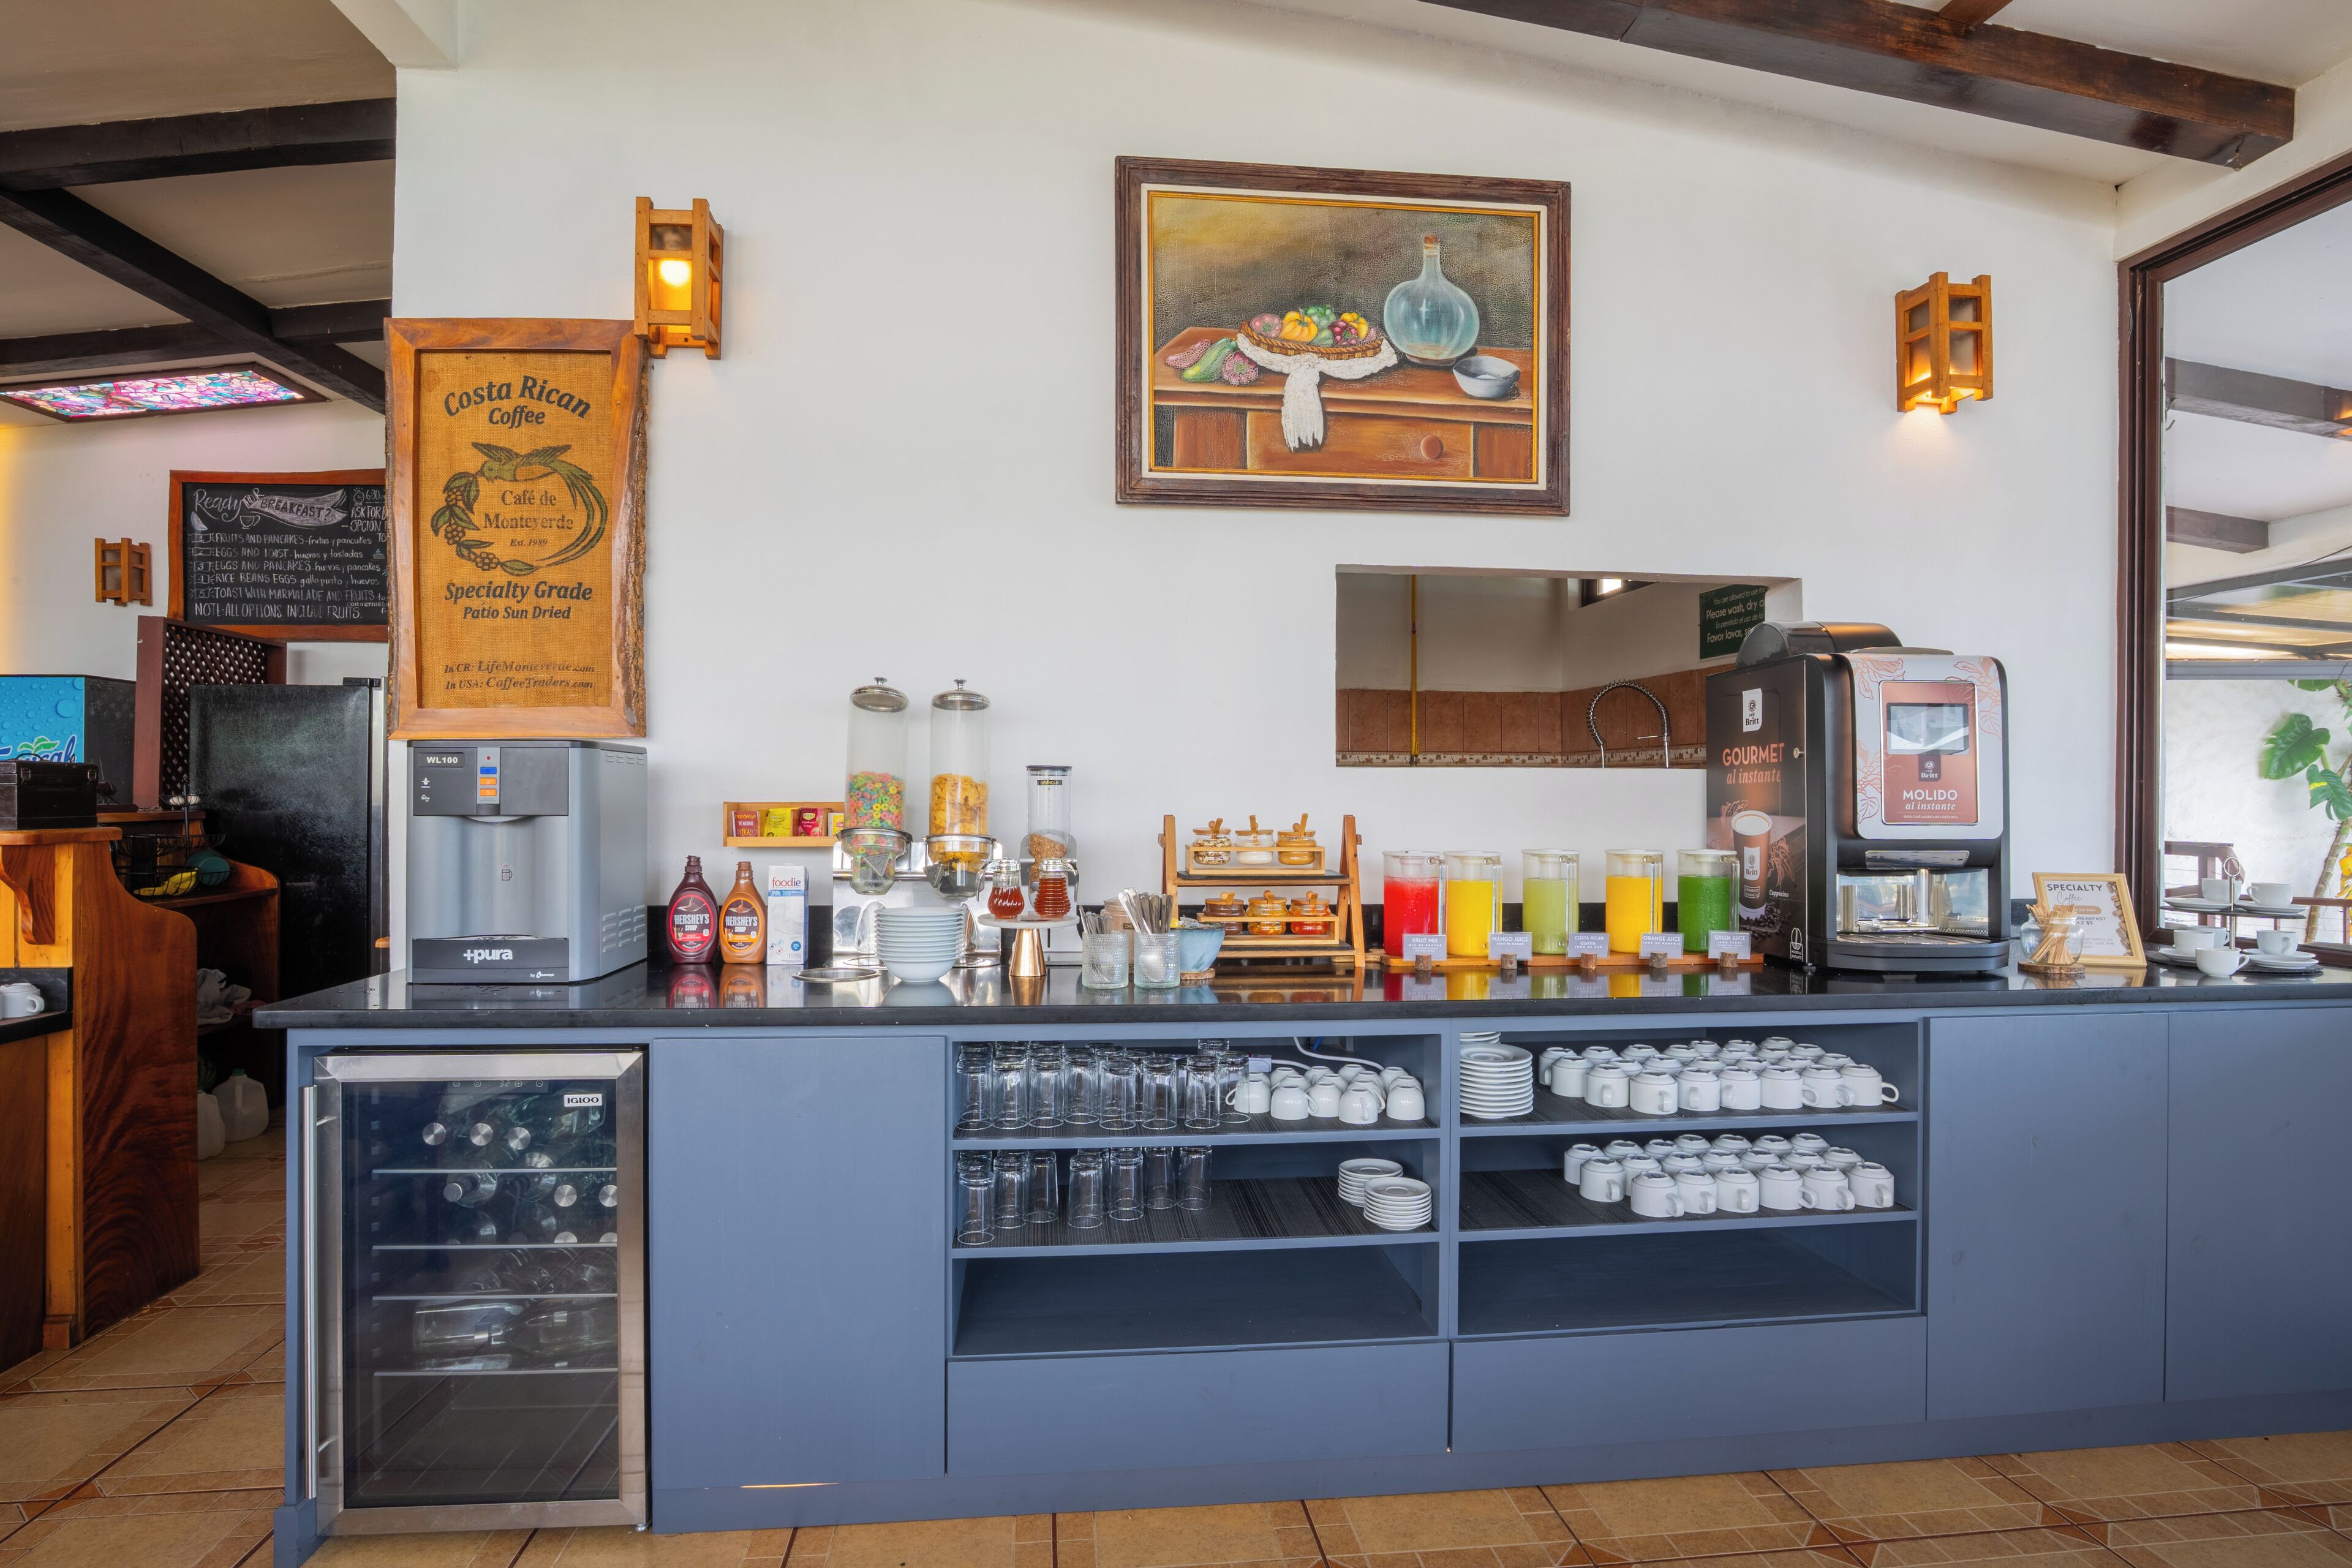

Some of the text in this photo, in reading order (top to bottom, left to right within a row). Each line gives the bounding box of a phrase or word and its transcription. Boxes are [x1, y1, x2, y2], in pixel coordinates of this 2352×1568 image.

[444, 374, 591, 419] Costa Rican
[488, 404, 546, 429] Coffee
[501, 489, 557, 506] Café de
[194, 489, 242, 522] Ready
[260, 498, 331, 521] BREAKFAST?
[351, 507, 365, 519] ASK
[483, 513, 574, 530] Monteverde
[216, 533, 244, 544] FRUITS
[246, 533, 264, 544] AND
[337, 536, 372, 547] pancakes
[510, 538, 548, 547] Est. 1989
[215, 546, 238, 557] EGGS
[241, 547, 260, 557] AND
[215, 560, 238, 570] EGGS
[241, 560, 260, 571] AND
[347, 562, 382, 573] pancakes
[215, 573, 235, 583] RICE
[240, 572, 270, 583] BEANS
[273, 573, 297, 584] EGGS
[300, 574, 319, 587] gallo
[320, 575, 343, 587] pinto
[351, 575, 380, 586] huevos
[214, 587, 243, 598] TOAST
[245, 586, 266, 599] WITH
[269, 589, 324, 601] MARMALADE
[326, 590, 343, 601] AND
[345, 589, 375, 601] FRUITS
[444, 580, 593, 605] Specialty Grade
[1728, 591, 1745, 601] allowed
[241, 603, 282, 618] OPTIONS
[462, 605, 571, 620] Patio Sun Dried
[1706, 599, 1758, 620] Please wash, dry
[1720, 617, 1739, 628] permitido
[1752, 612, 1758, 621] de
[1706, 628, 1743, 643] Favor lavar,
[444, 665, 454, 673] In
[445, 680, 456, 690] In
[459, 680, 483, 689] USA:
[1745, 717, 1760, 726] Britt
[1722, 742, 1785, 766] GOURMET
[1726, 767, 1781, 785] al instante
[1902, 789, 1958, 801] MOLIDO
[1905, 801, 1956, 810] al instante
[772, 877, 801, 888] foodie
[2057, 891, 2082, 906] Coffee
[674, 913, 710, 925] HERSHEY'S
[725, 916, 758, 926] HERSHEY'S
[463, 949, 513, 963] +pura
